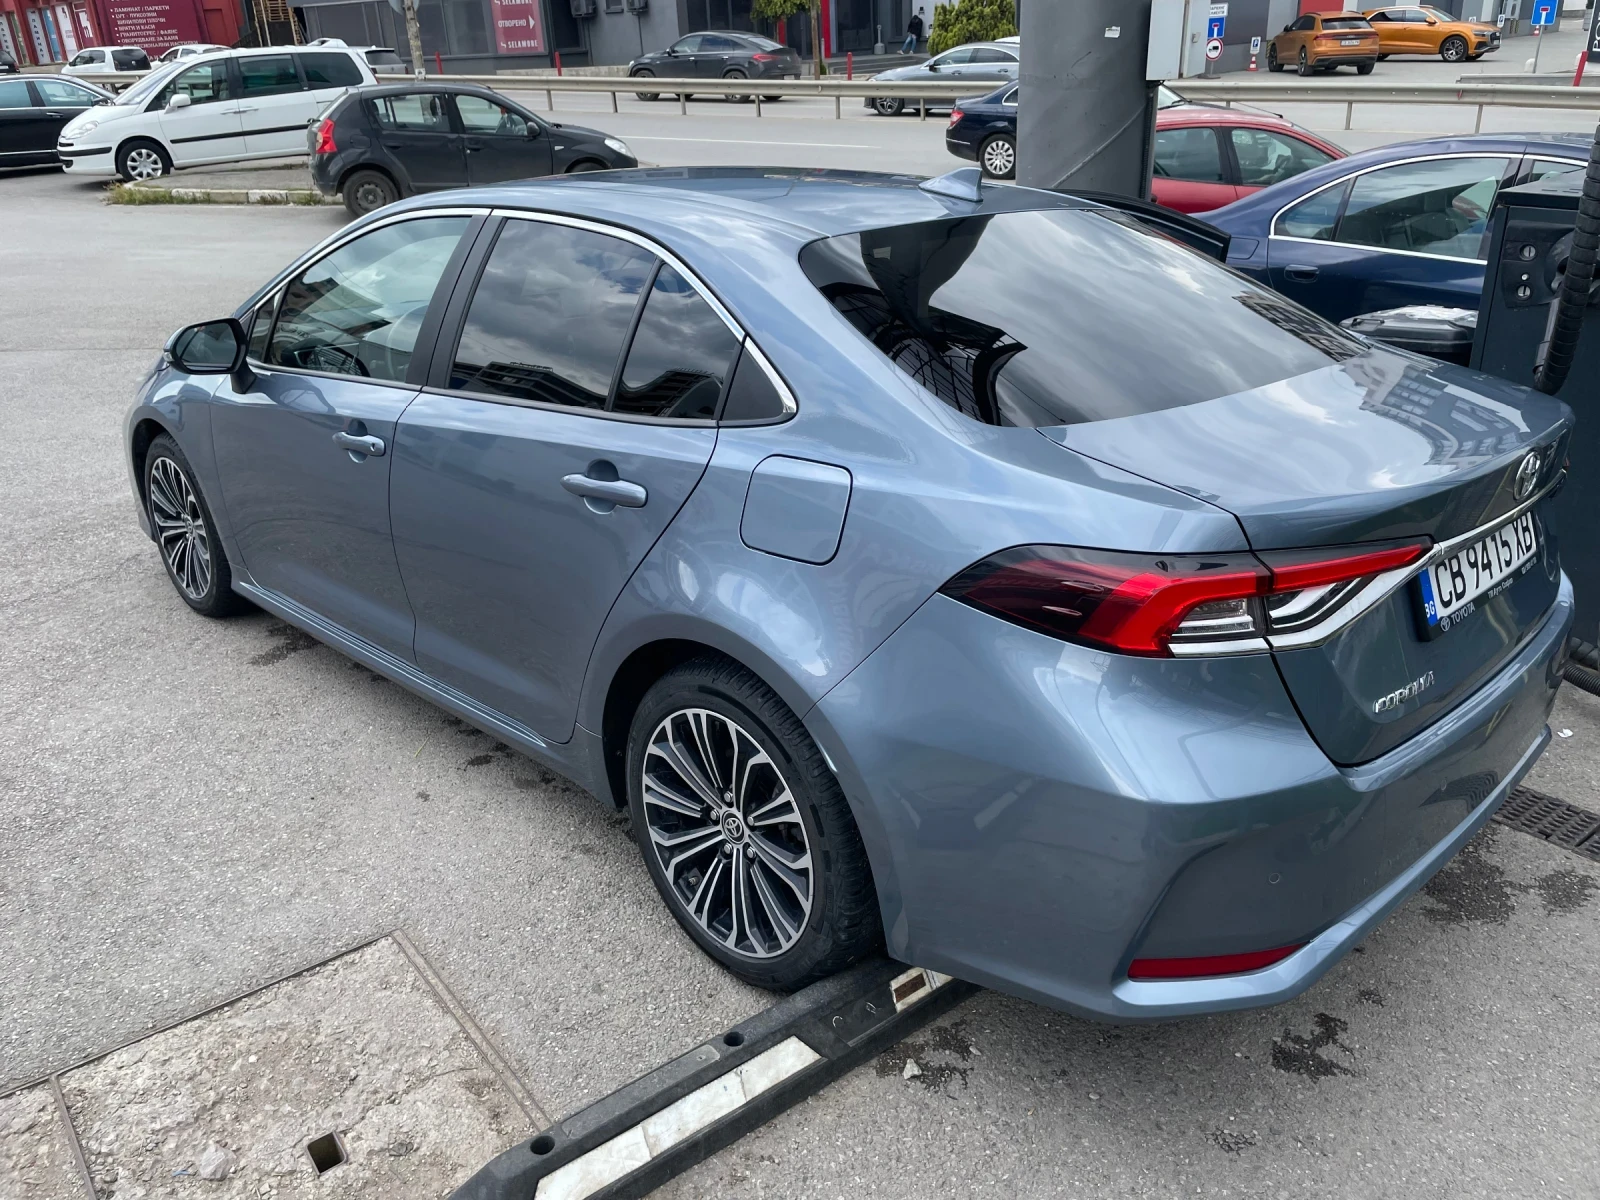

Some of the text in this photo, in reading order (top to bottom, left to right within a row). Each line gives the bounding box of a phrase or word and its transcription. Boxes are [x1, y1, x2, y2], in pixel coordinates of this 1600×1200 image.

[498, 19, 526, 27] ОТВОРЕНО
[507, 40, 538, 48] SELAMORE
[1434, 512, 1533, 609] CB 9415 XB
[1425, 600, 1435, 618] BG
[1451, 601, 1476, 625] TOYOTA
